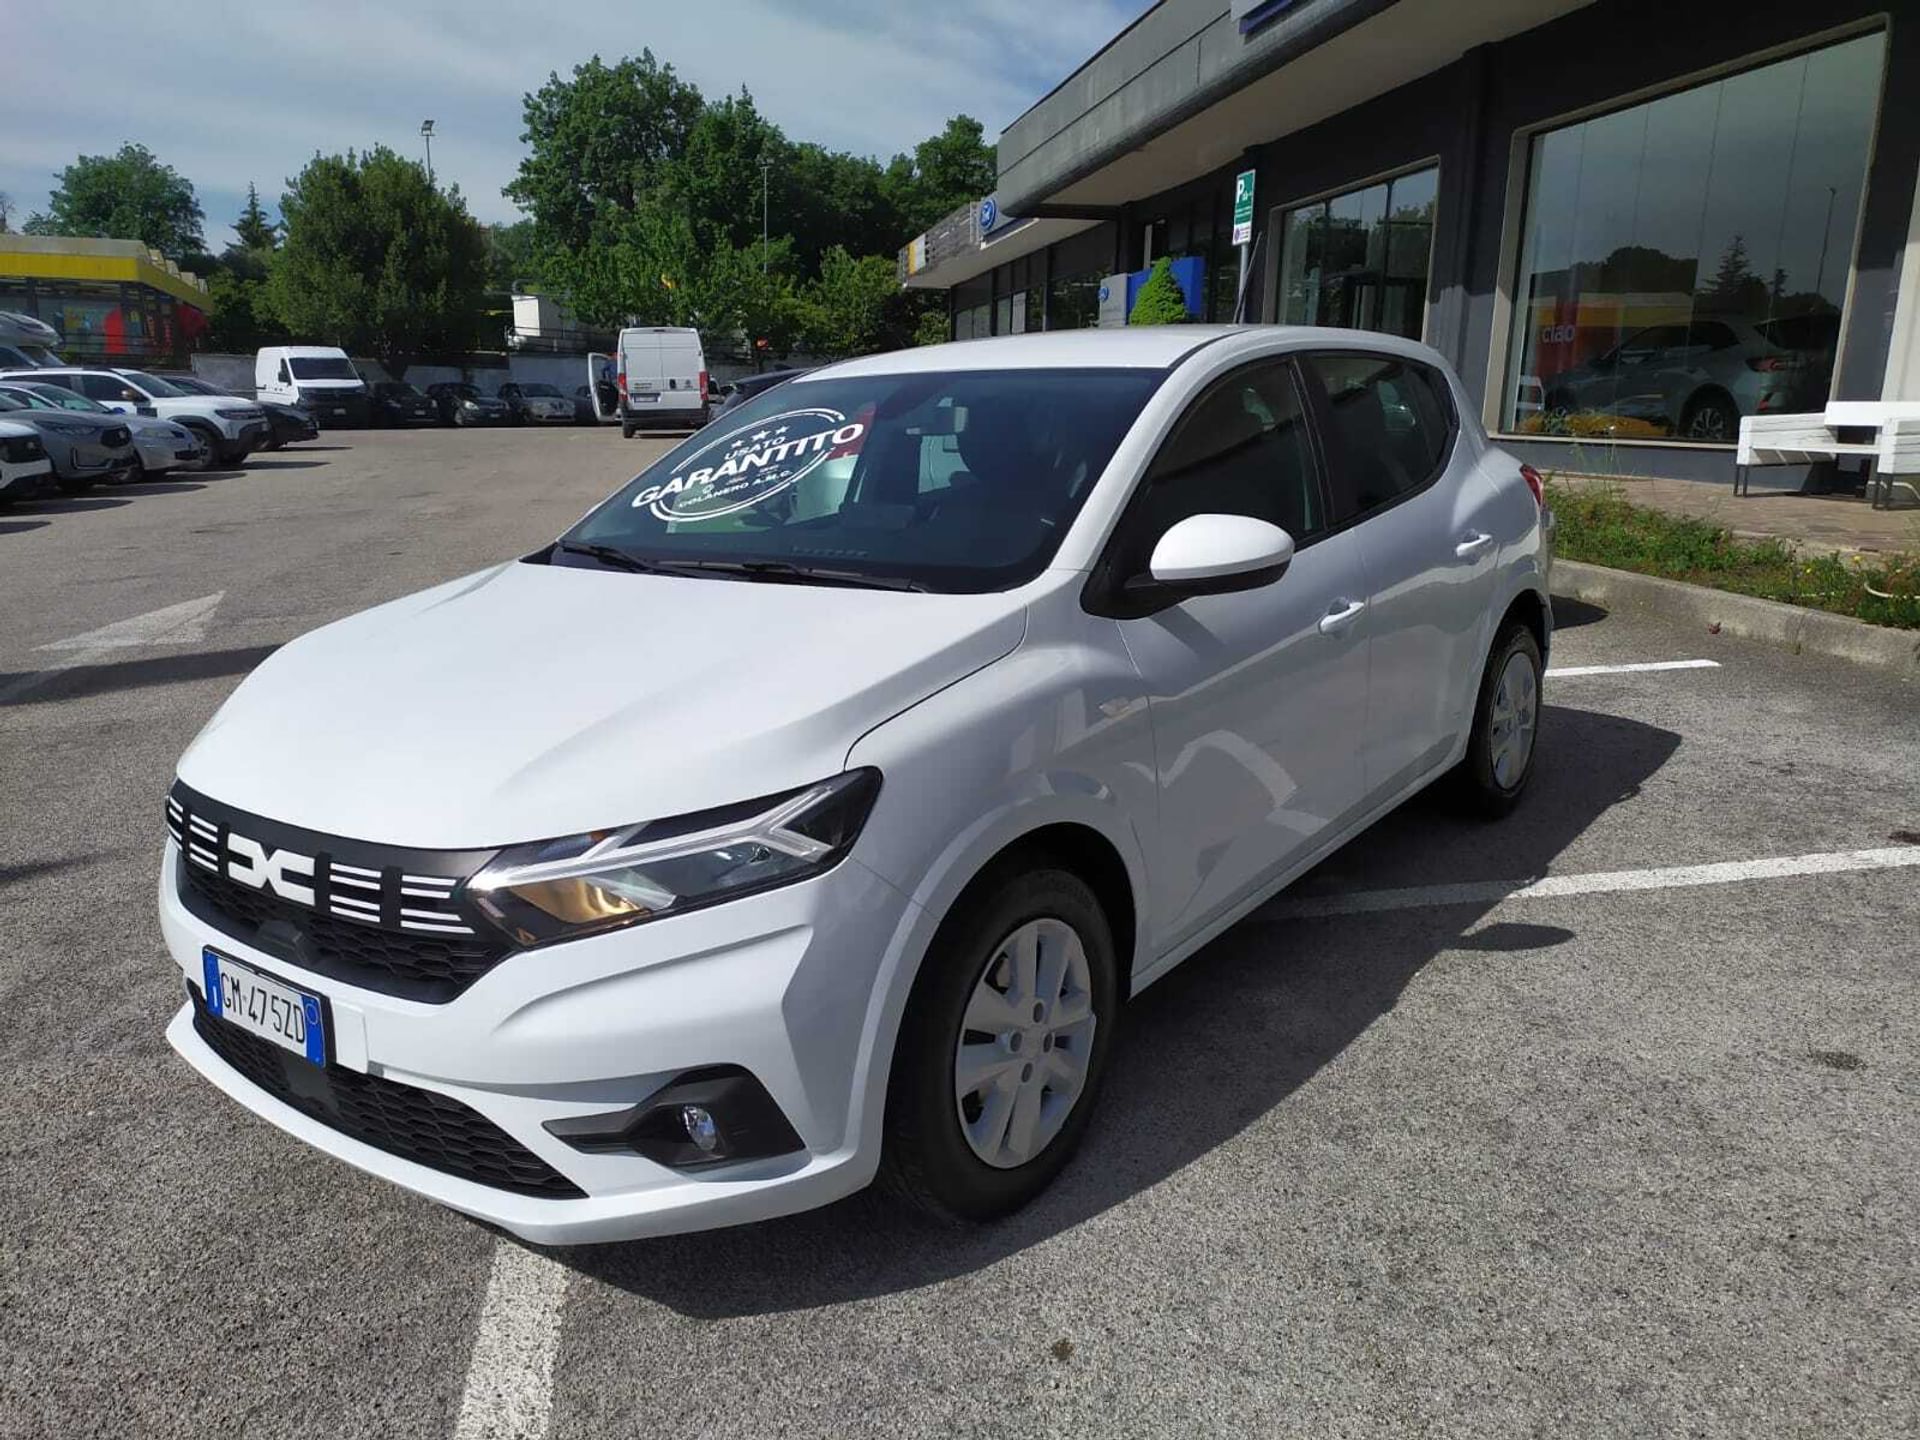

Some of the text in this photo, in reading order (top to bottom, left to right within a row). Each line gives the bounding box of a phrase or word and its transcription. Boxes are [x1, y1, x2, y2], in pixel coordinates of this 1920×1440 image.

[1542, 324, 1576, 344] ciao
[724, 436, 786, 461] USATO
[631, 423, 864, 508] GARANTITO
